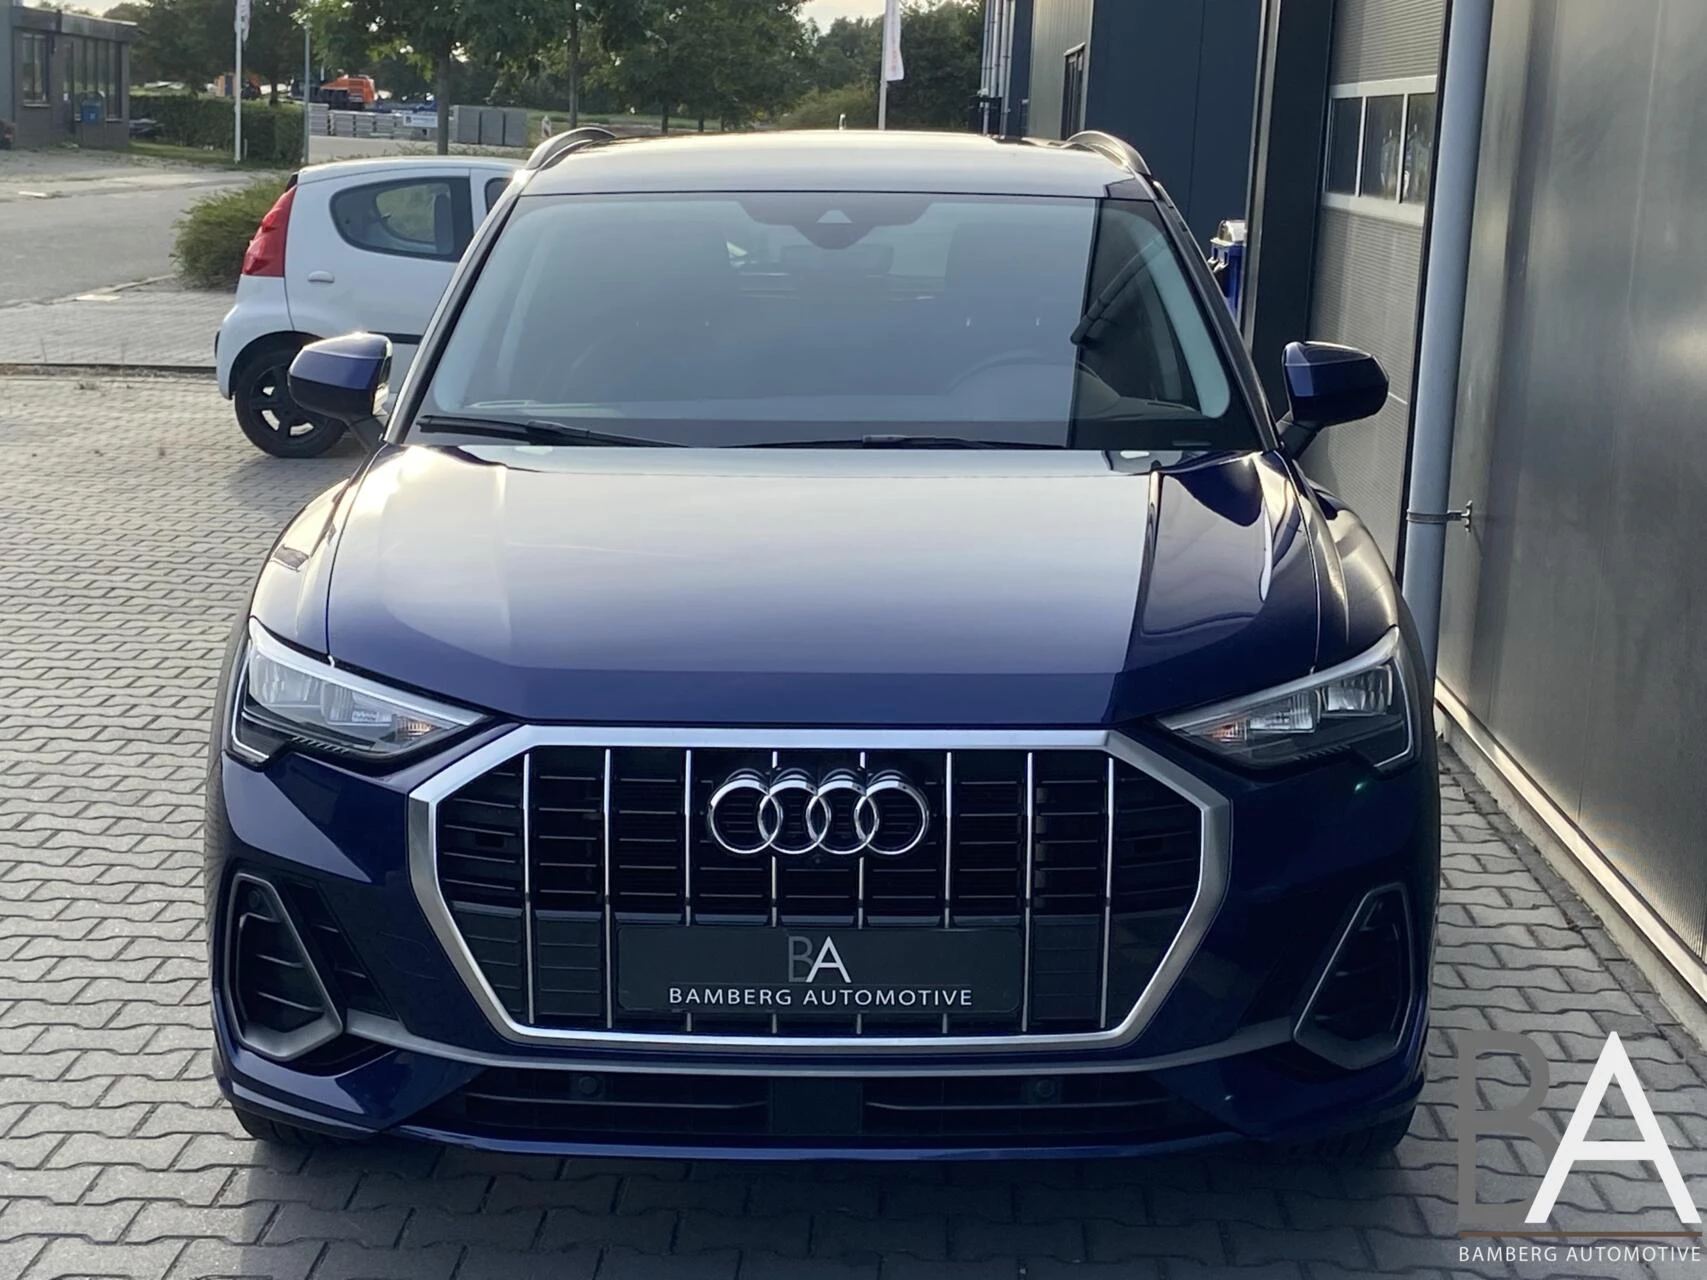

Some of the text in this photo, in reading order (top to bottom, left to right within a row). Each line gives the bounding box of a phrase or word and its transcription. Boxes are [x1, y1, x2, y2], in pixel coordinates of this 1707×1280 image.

[787, 935, 851, 983] BA
[668, 987, 973, 1006] BAMBERG AUTOMOTIVE
